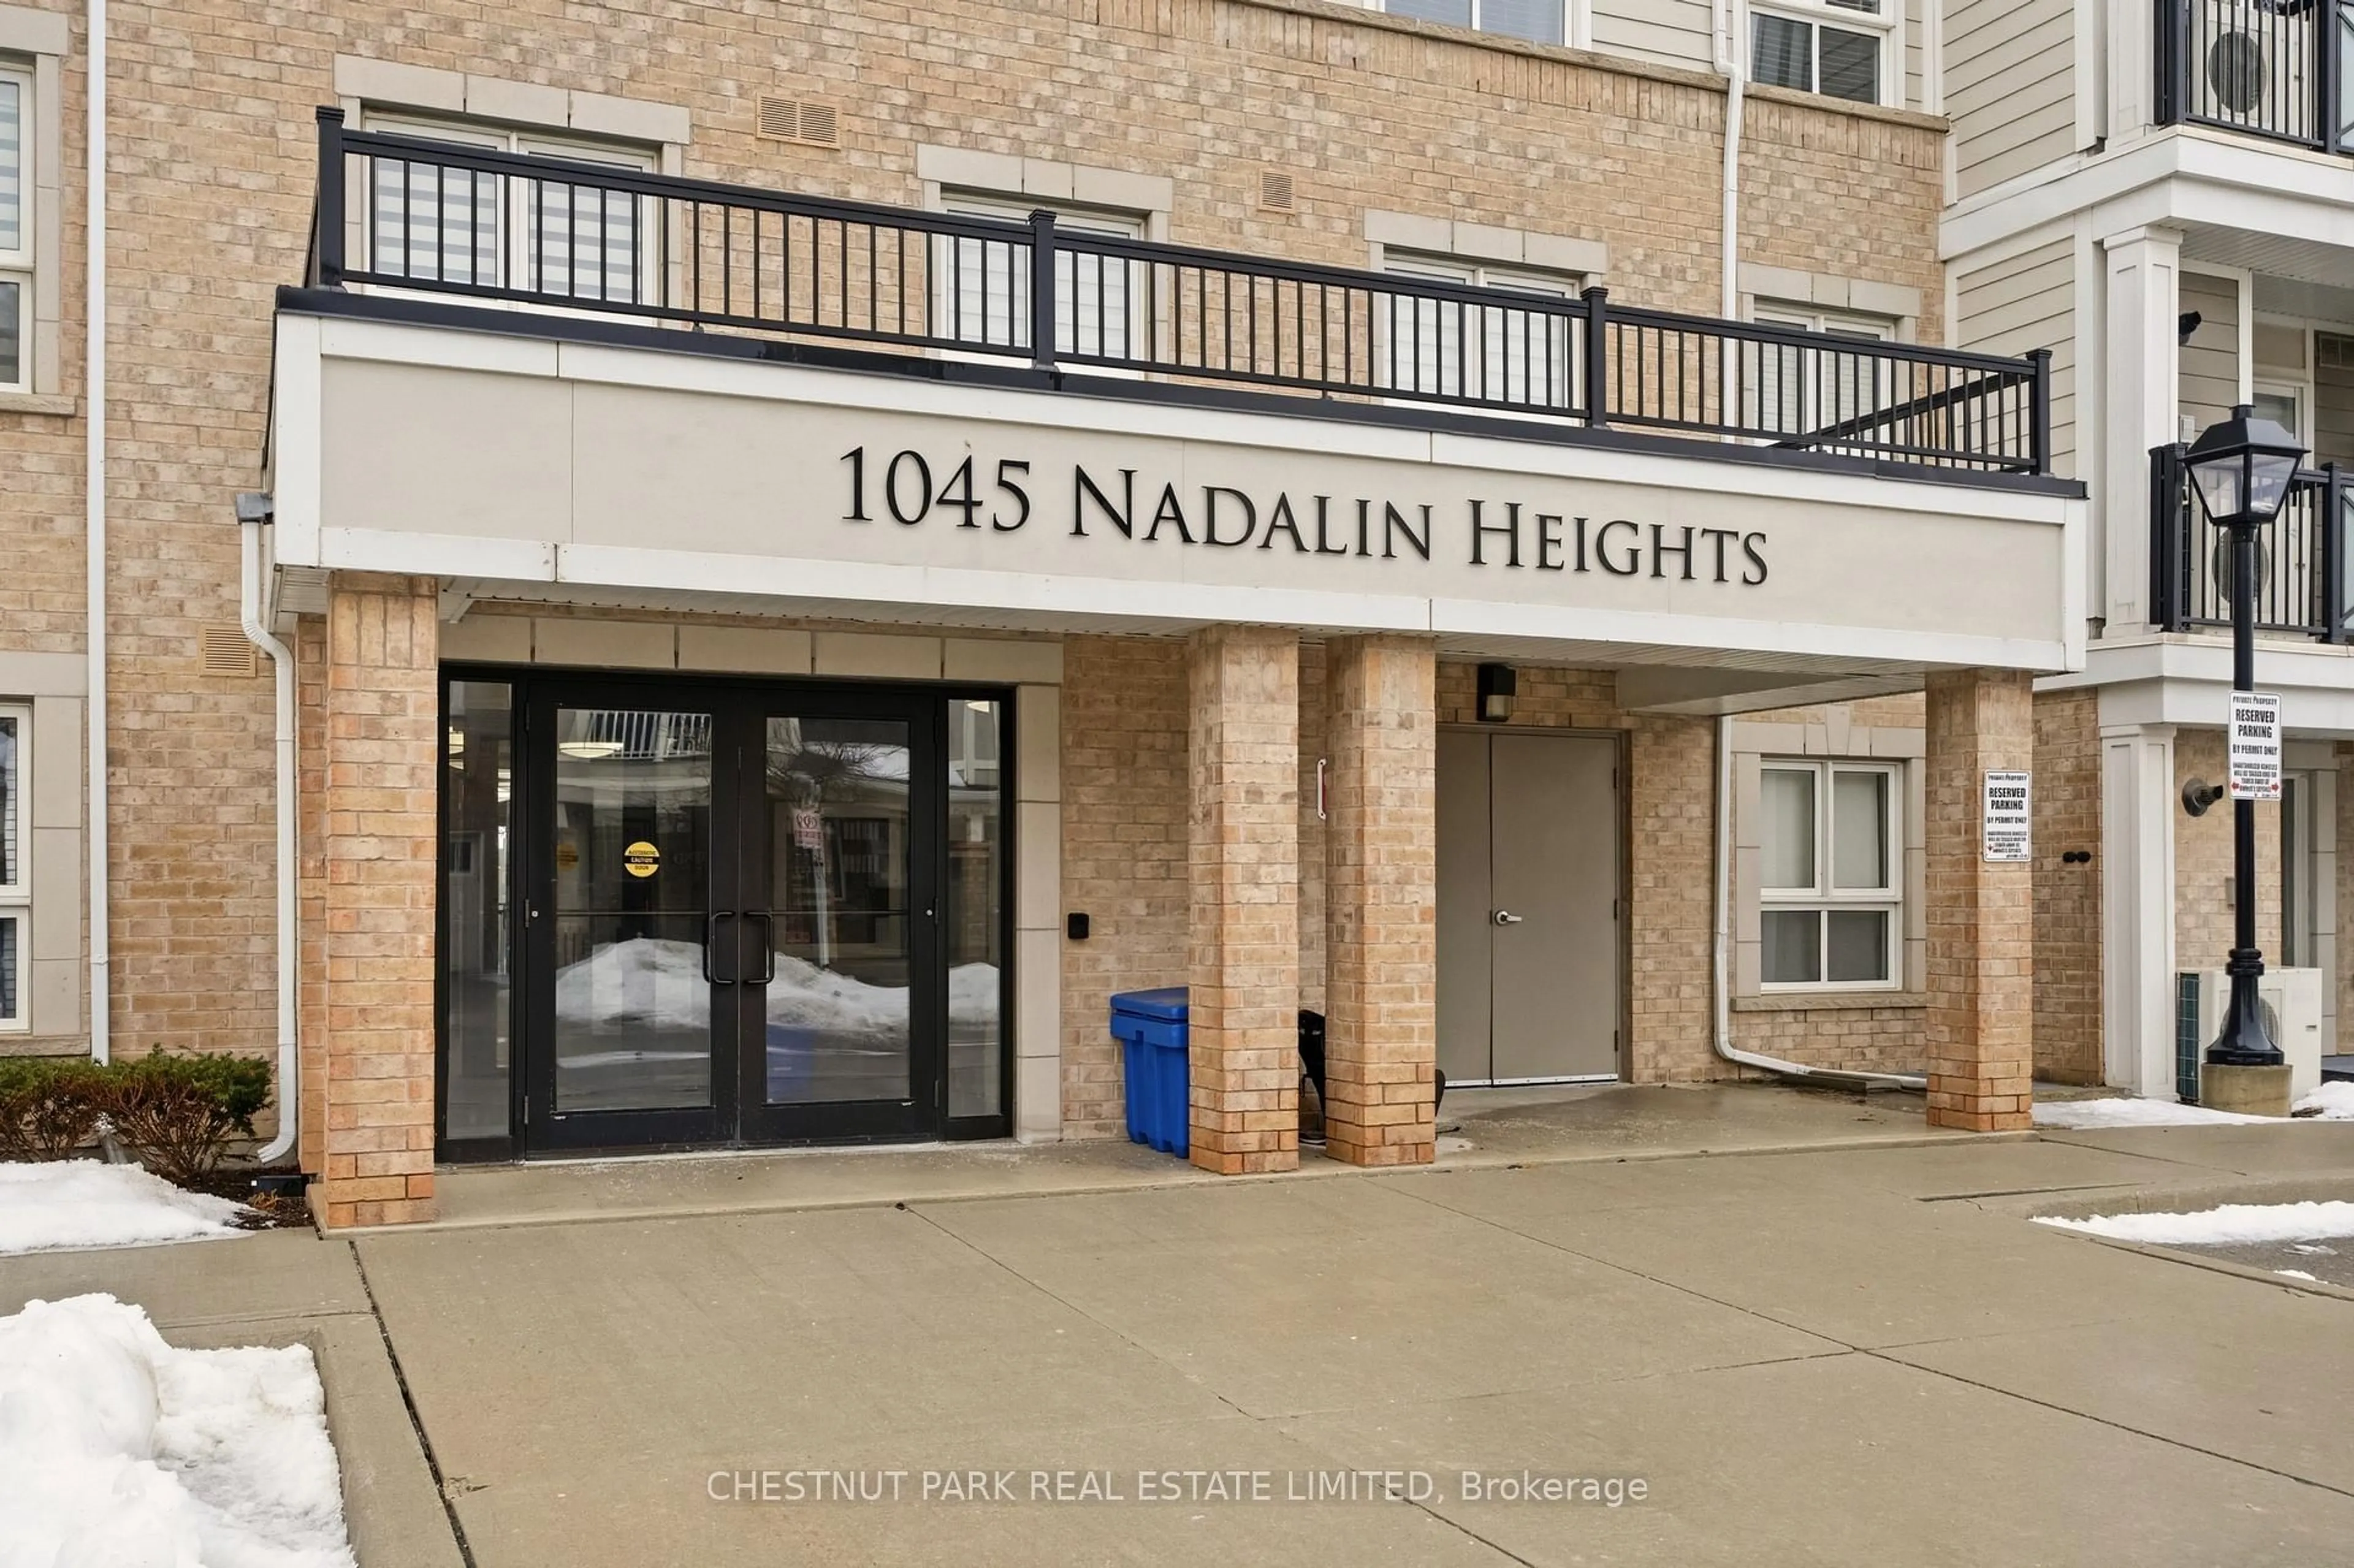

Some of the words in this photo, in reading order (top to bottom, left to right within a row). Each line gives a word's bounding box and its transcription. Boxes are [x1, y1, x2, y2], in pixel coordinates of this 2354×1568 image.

[841, 446, 1030, 531] 1045
[1070, 465, 1432, 561] NADALIN
[1469, 500, 1767, 586] HEIGHTS
[2236, 709, 2275, 723] RESERVED
[2238, 725, 2272, 738] PARKING
[2233, 744, 2239, 753] BY
[2241, 745, 2263, 755] PERMIT
[2264, 746, 2277, 755] ONLY
[1989, 787, 2026, 797] RESERVED
[1991, 799, 2023, 810] PARKING
